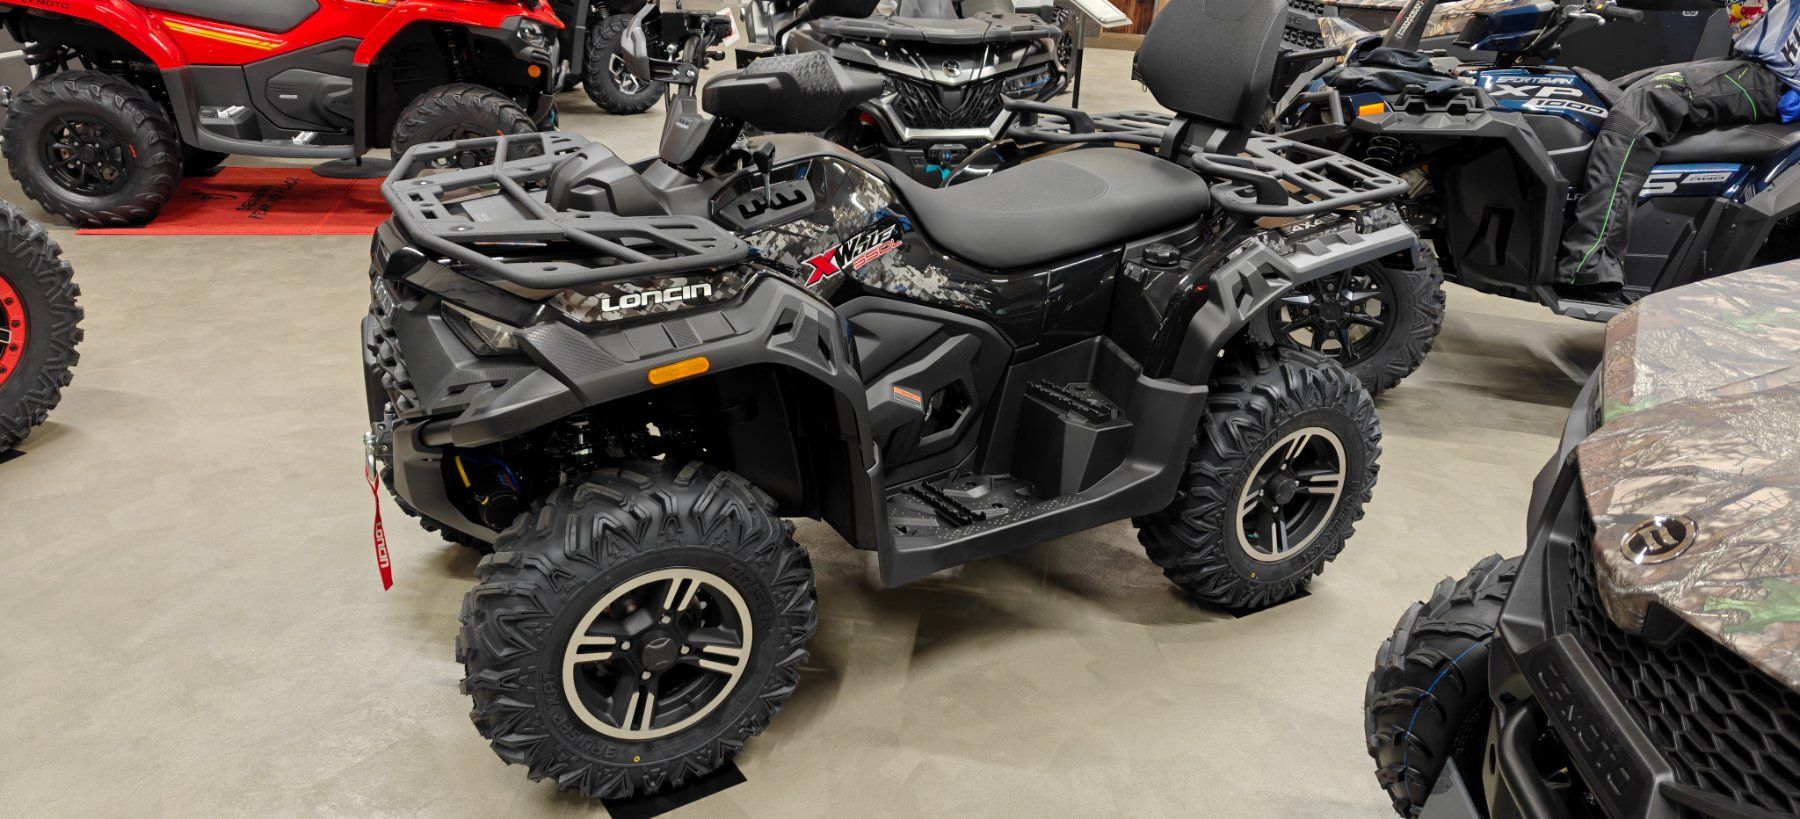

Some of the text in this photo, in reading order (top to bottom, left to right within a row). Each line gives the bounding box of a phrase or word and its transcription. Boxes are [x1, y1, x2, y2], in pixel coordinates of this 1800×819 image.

[1496, 76, 1574, 85] SPORTSMAN
[1488, 84, 1583, 98] XP
[1535, 99, 1608, 119] 1000
[852, 239, 902, 270] 550L
